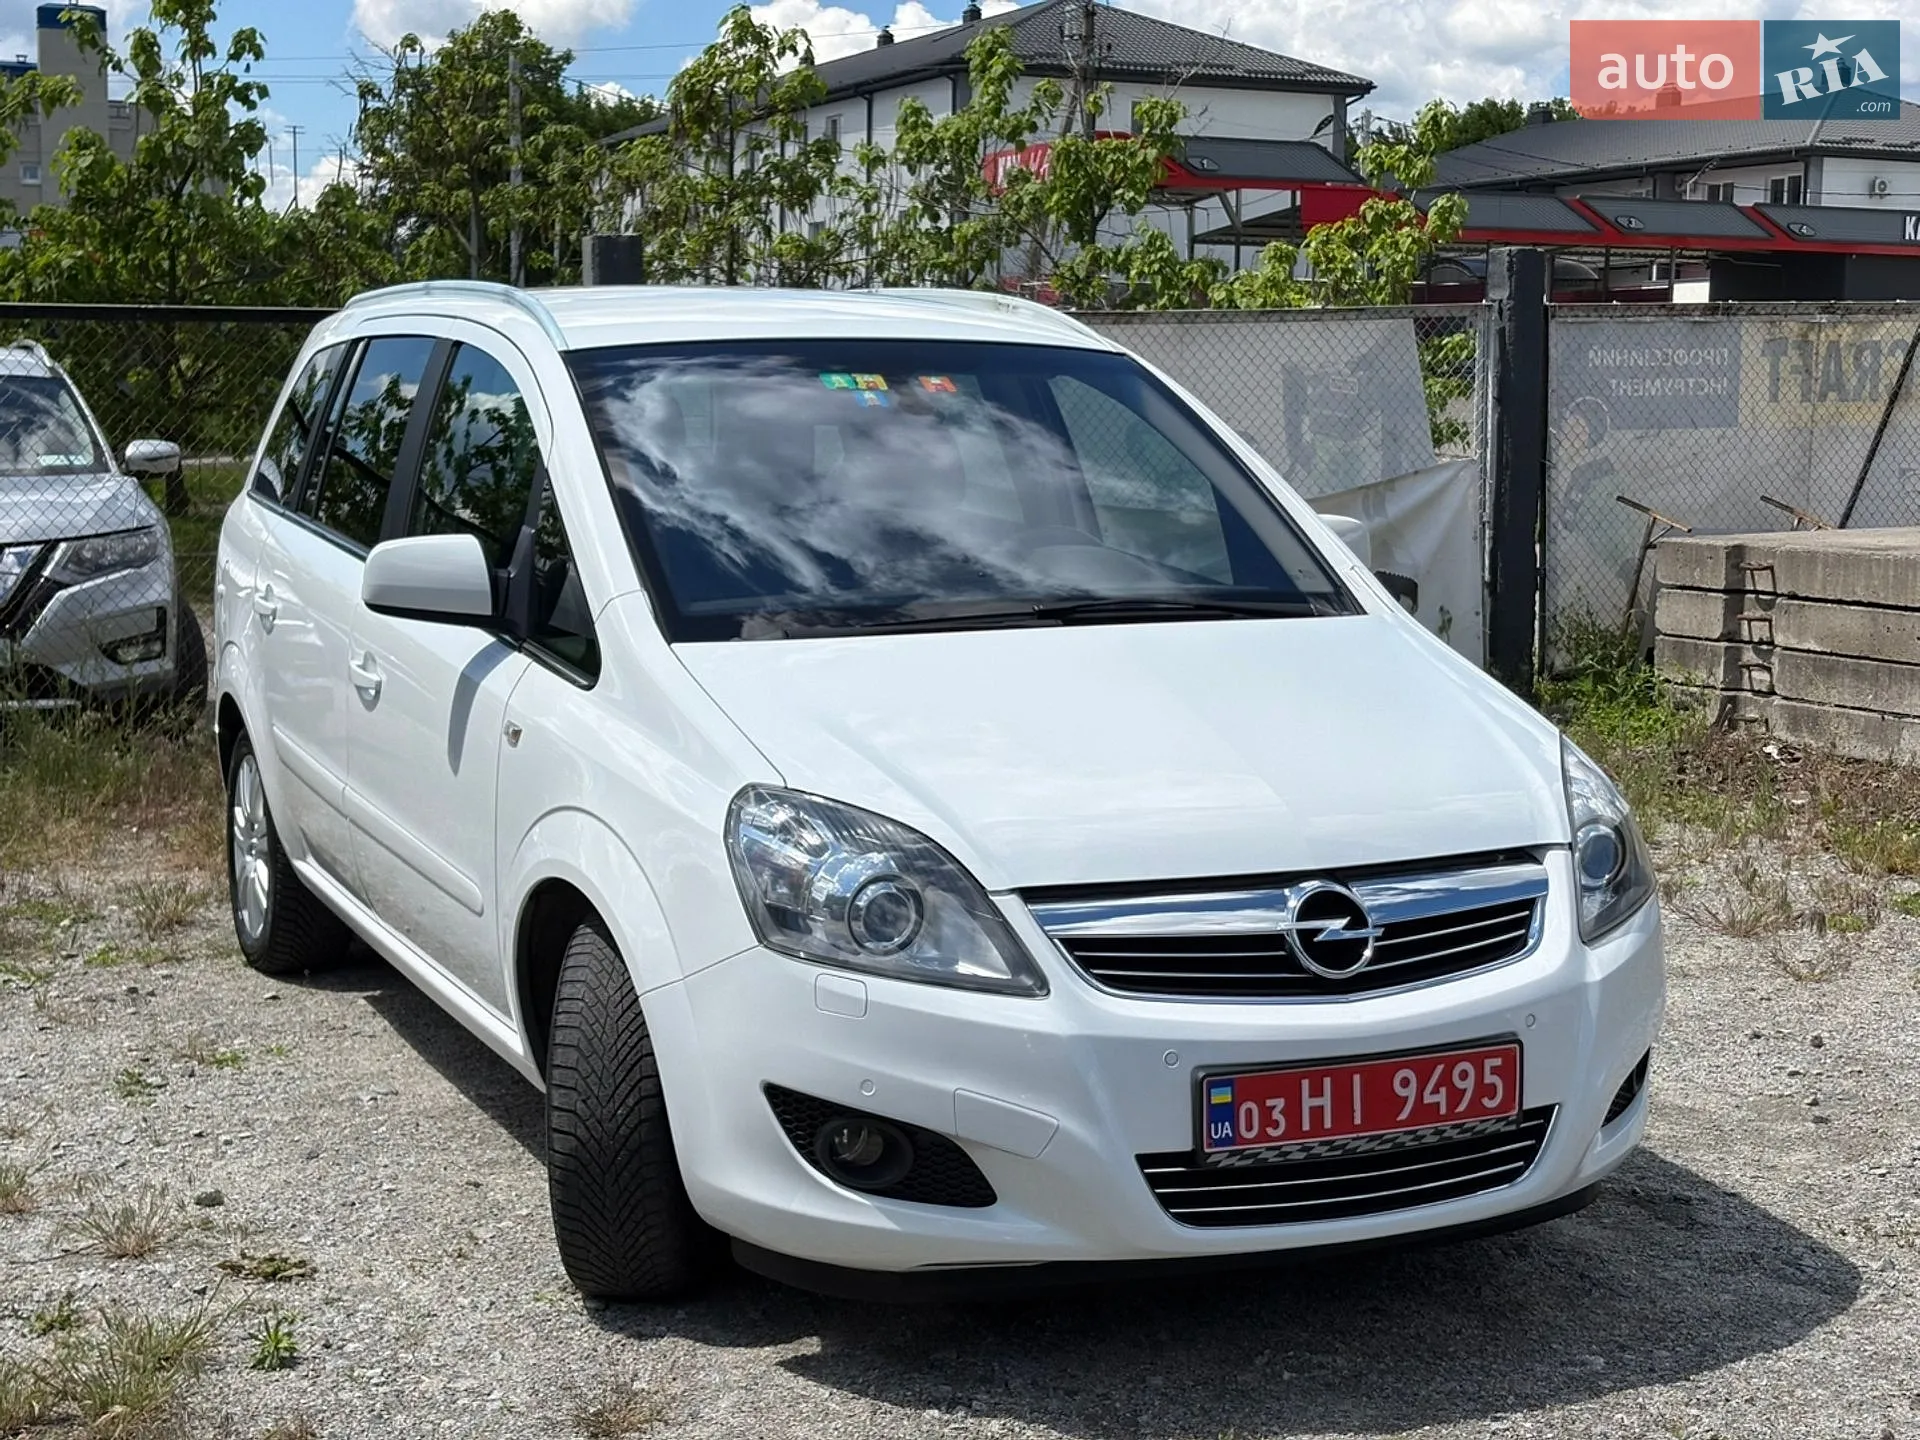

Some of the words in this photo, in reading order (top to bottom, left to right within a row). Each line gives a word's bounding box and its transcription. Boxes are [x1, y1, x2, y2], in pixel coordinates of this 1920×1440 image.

[1238, 1097, 1287, 1140] 03
[1392, 1057, 1504, 1122] 9495
[1209, 1121, 1234, 1140] UA
